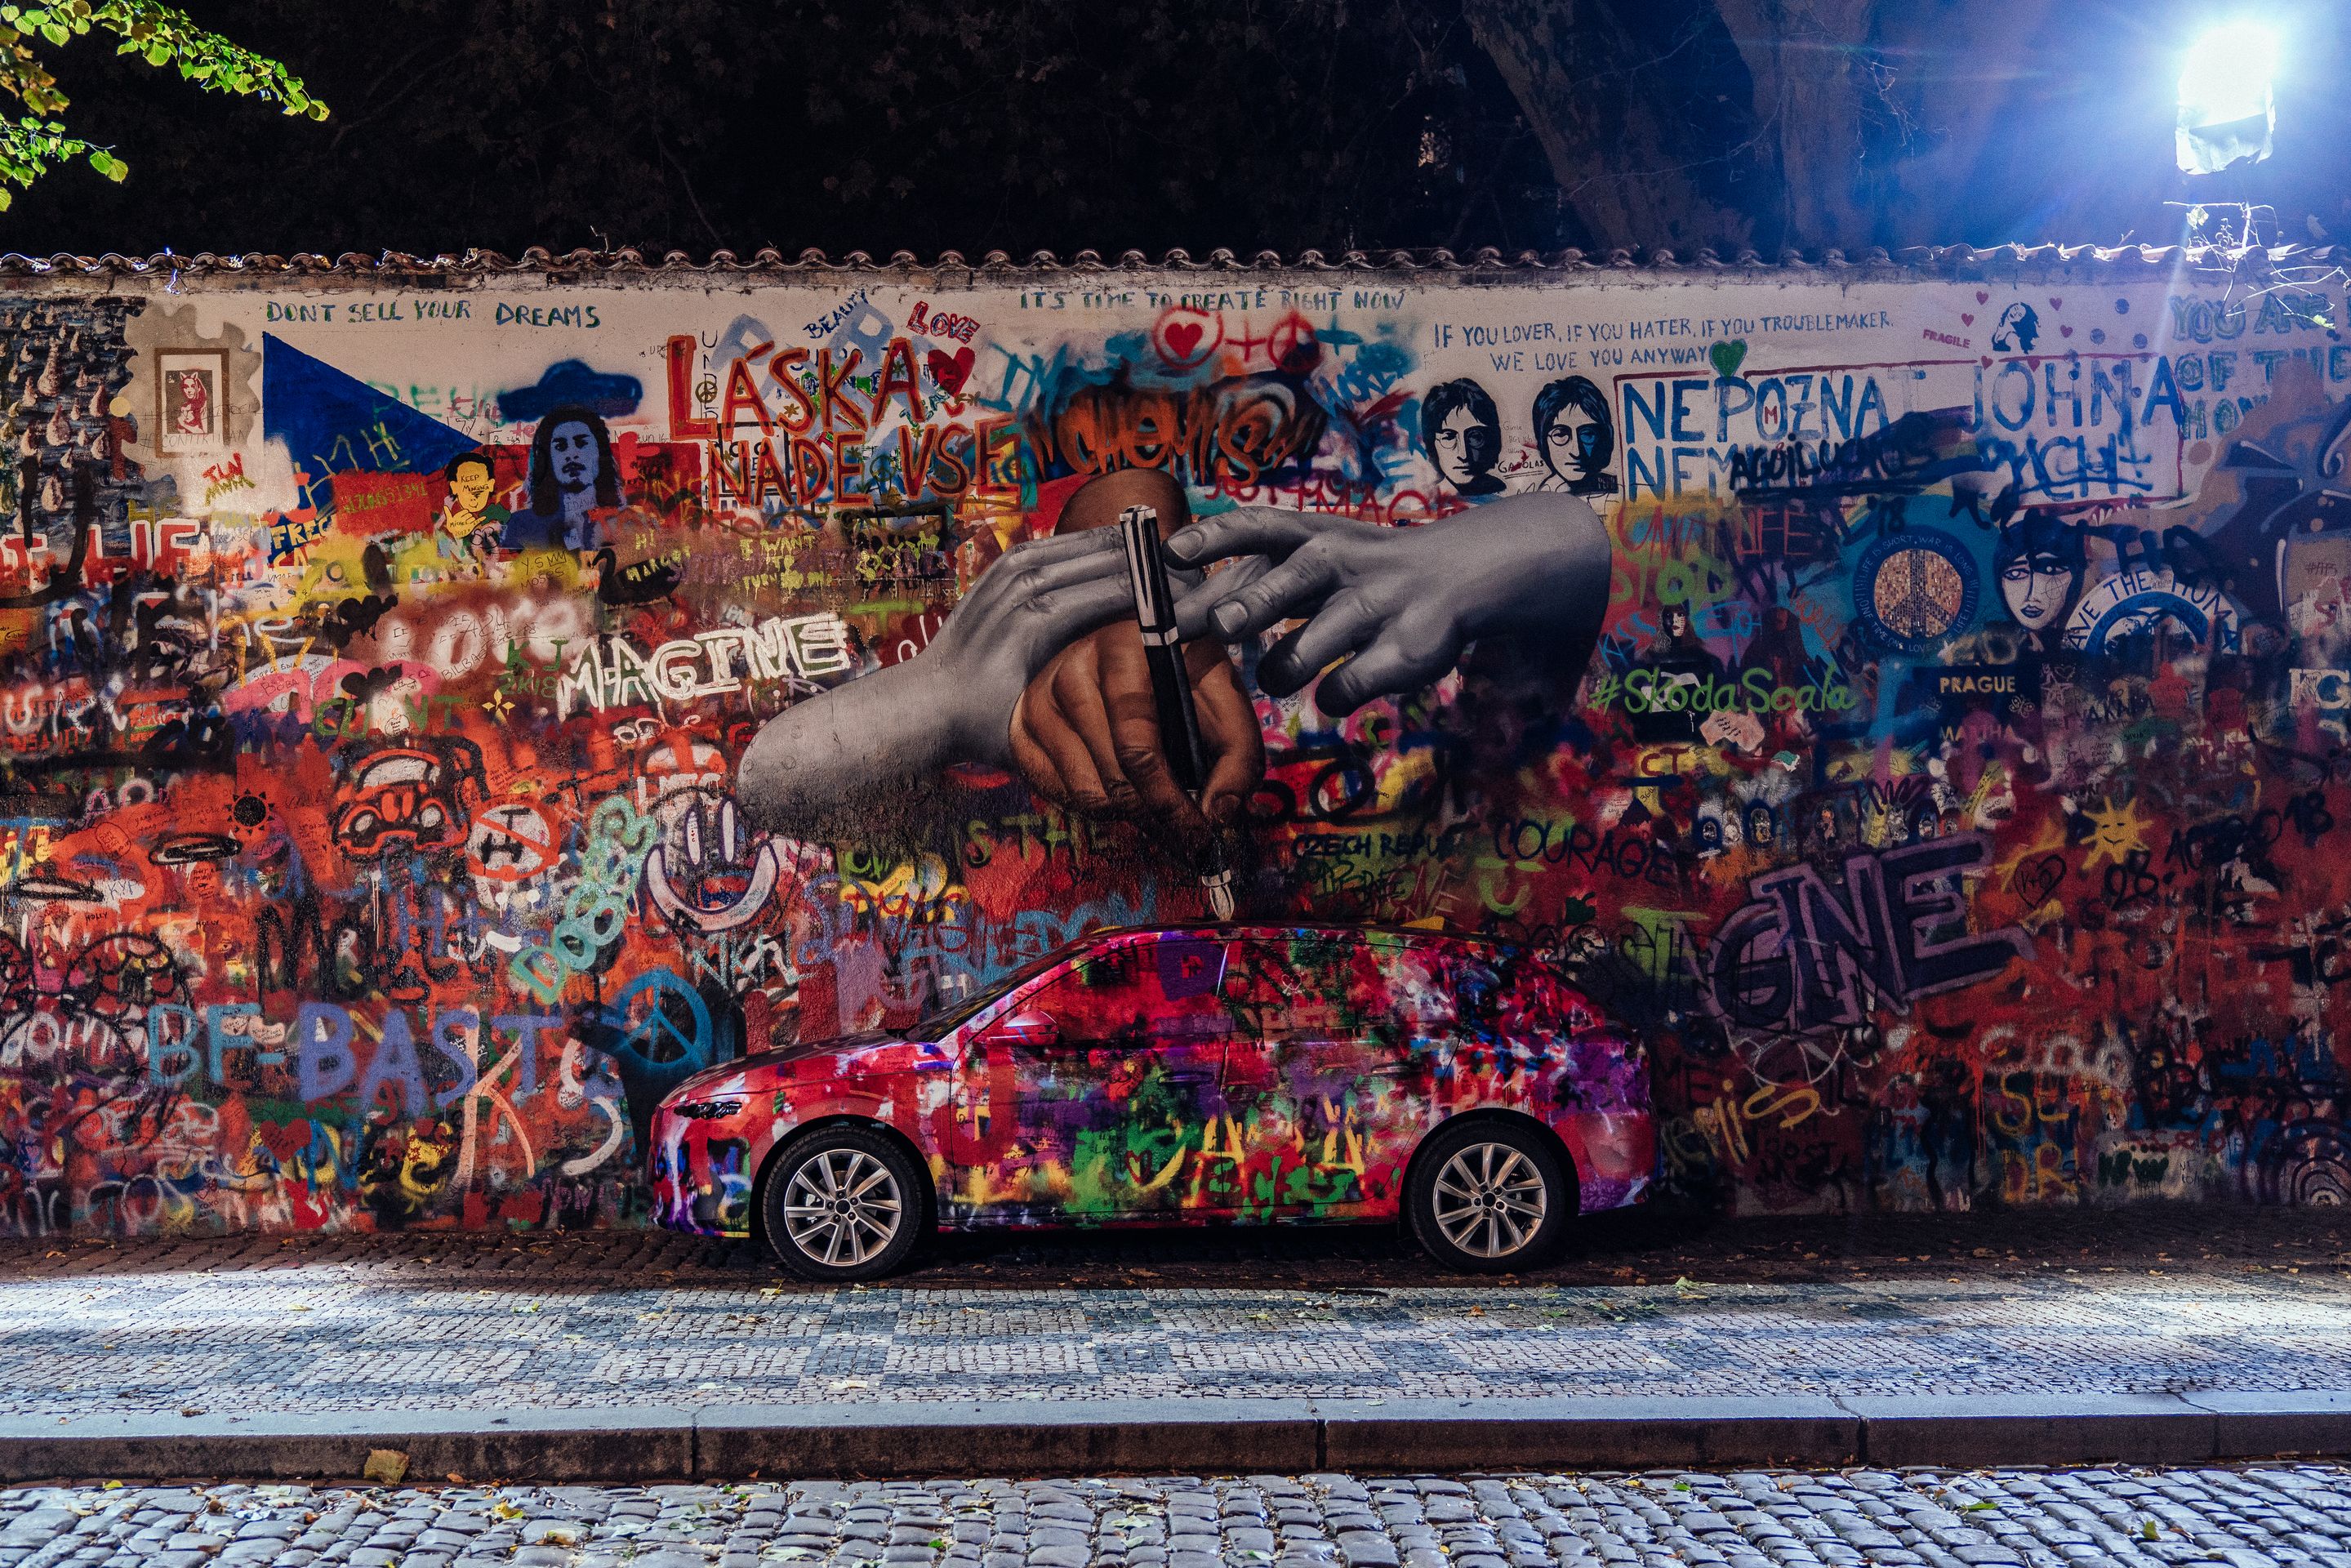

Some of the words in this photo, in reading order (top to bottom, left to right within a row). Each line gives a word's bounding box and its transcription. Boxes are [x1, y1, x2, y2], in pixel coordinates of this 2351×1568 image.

[267, 301, 336, 322] DONT
[348, 303, 404, 323] SELL
[414, 300, 471, 319] YOUR
[496, 302, 601, 327] DREAMS
[803, 288, 870, 339] BEAUTY
[1020, 292, 1065, 310] IT'S
[1081, 291, 1135, 310] TIME
[1146, 292, 1175, 312] TO
[1181, 290, 1267, 312] CREATE
[1281, 291, 1342, 312] RIGHT
[1353, 290, 1406, 310] NOW
[906, 301, 981, 344] LOVE
[2171, 293, 2246, 343] YOU
[1435, 323, 1452, 348] IF
[1462, 325, 1498, 346] YOU
[1567, 325, 1582, 342] IF
[1587, 323, 1623, 341] YOU
[1702, 319, 1716, 338] IF
[1721, 318, 1755, 337] YOU
[1922, 329, 1970, 349] FRAGILE
[1490, 352, 1523, 372] WE
[1535, 351, 1577, 371] LOVE
[1589, 347, 1623, 368] YOU
[1631, 346, 1708, 365] ANYWAY
[2175, 350, 2237, 392] OF
[461, 473, 480, 483] KEEP
[708, 430, 872, 510] NADE
[1498, 460, 1544, 474] GAOLAS
[760, 534, 815, 559] WANT
[1919, 536, 1942, 547] WAR
[1945, 544, 1954, 553] IS
[1954, 552, 1974, 576] LONG
[2066, 600, 2102, 650] AVE
[2103, 570, 2152, 602] THE
[1872, 621, 1889, 641] TIME
[1587, 660, 1858, 715] #SkodaScala
[1939, 675, 2016, 694] PRAGUE
[1495, 818, 1676, 889] COURAGE
[198, 1199, 219, 1209] XOXO
